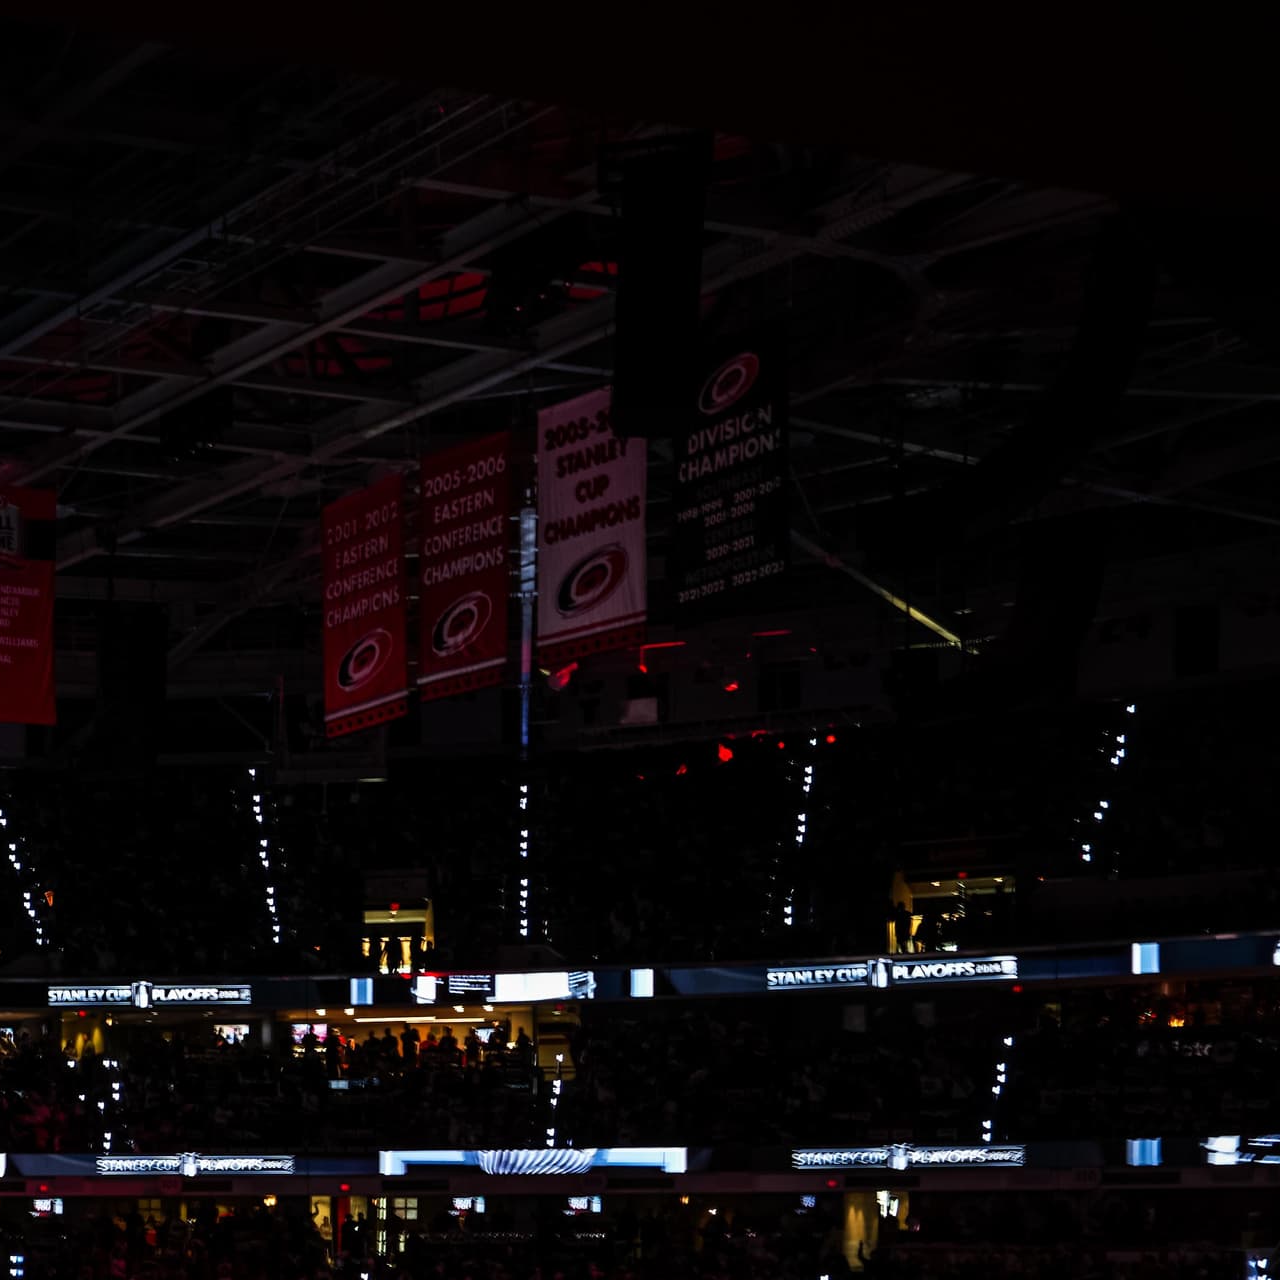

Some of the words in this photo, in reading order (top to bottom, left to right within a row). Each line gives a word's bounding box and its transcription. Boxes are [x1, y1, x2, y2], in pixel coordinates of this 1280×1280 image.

[687, 403, 774, 456] DIVISION
[424, 450, 507, 499] 2005-2006
[556, 436, 628, 479] STANLEY
[433, 487, 495, 526] EASTERN
[575, 473, 611, 505] CUP
[424, 513, 505, 557] CONFERENCE
[543, 494, 642, 546] CHAMPIONS
[335, 532, 389, 570] EASTERN
[423, 545, 505, 586] CHAMPIONS
[325, 556, 400, 600] CONFERENCE
[326, 584, 401, 629] CHAMPIONS
[767, 969, 835, 986] STANLEY
[836, 967, 868, 982] CUP
[891, 962, 975, 980] PLAYOFFS
[47, 989, 103, 1002] STANLEY
[105, 989, 132, 1002] CUP
[152, 988, 218, 1001] PLAYOFFS
[96, 1160, 151, 1171] STANLEY
[153, 1160, 180, 1171] CUP
[198, 1159, 263, 1171] PLAYOFFS
[793, 1152, 856, 1166] STANLEY
[858, 1151, 888, 1165] CUP
[910, 1149, 987, 1164] PLAYOFFS
